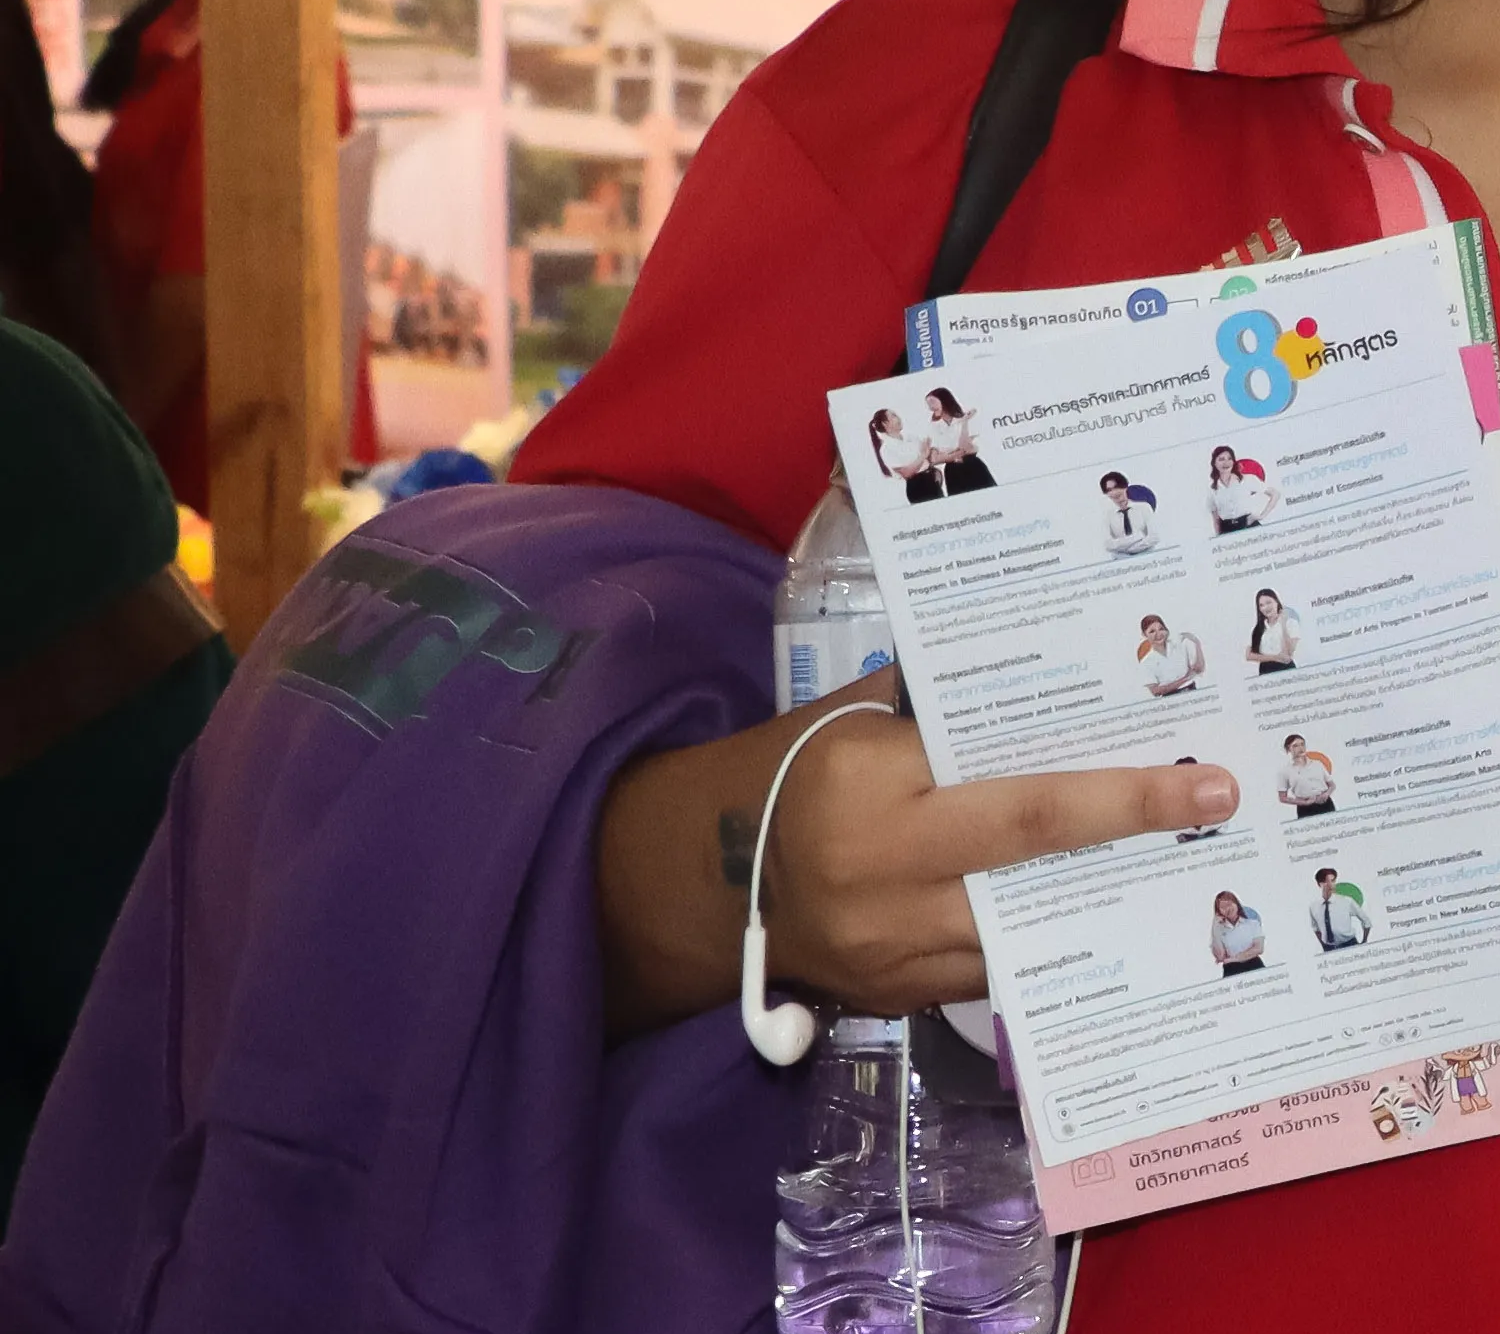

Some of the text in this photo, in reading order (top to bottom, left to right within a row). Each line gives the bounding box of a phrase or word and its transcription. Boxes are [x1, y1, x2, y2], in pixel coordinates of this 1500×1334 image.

[1134, 297, 1160, 317] 01
[1215, 308, 1398, 421] 8 หลักสูตร
[991, 363, 1211, 429] คณะบริหารธุรกิจและนิเทศศาสตร์
[1279, 1077, 1372, 1113] ผู้ช่วยนักวิจัย
[1128, 1110, 1340, 1172] นักวิทยาศาสตร์ นักวิชาการ
[1134, 1151, 1251, 1193] นิติวิทยาศาสตร์
